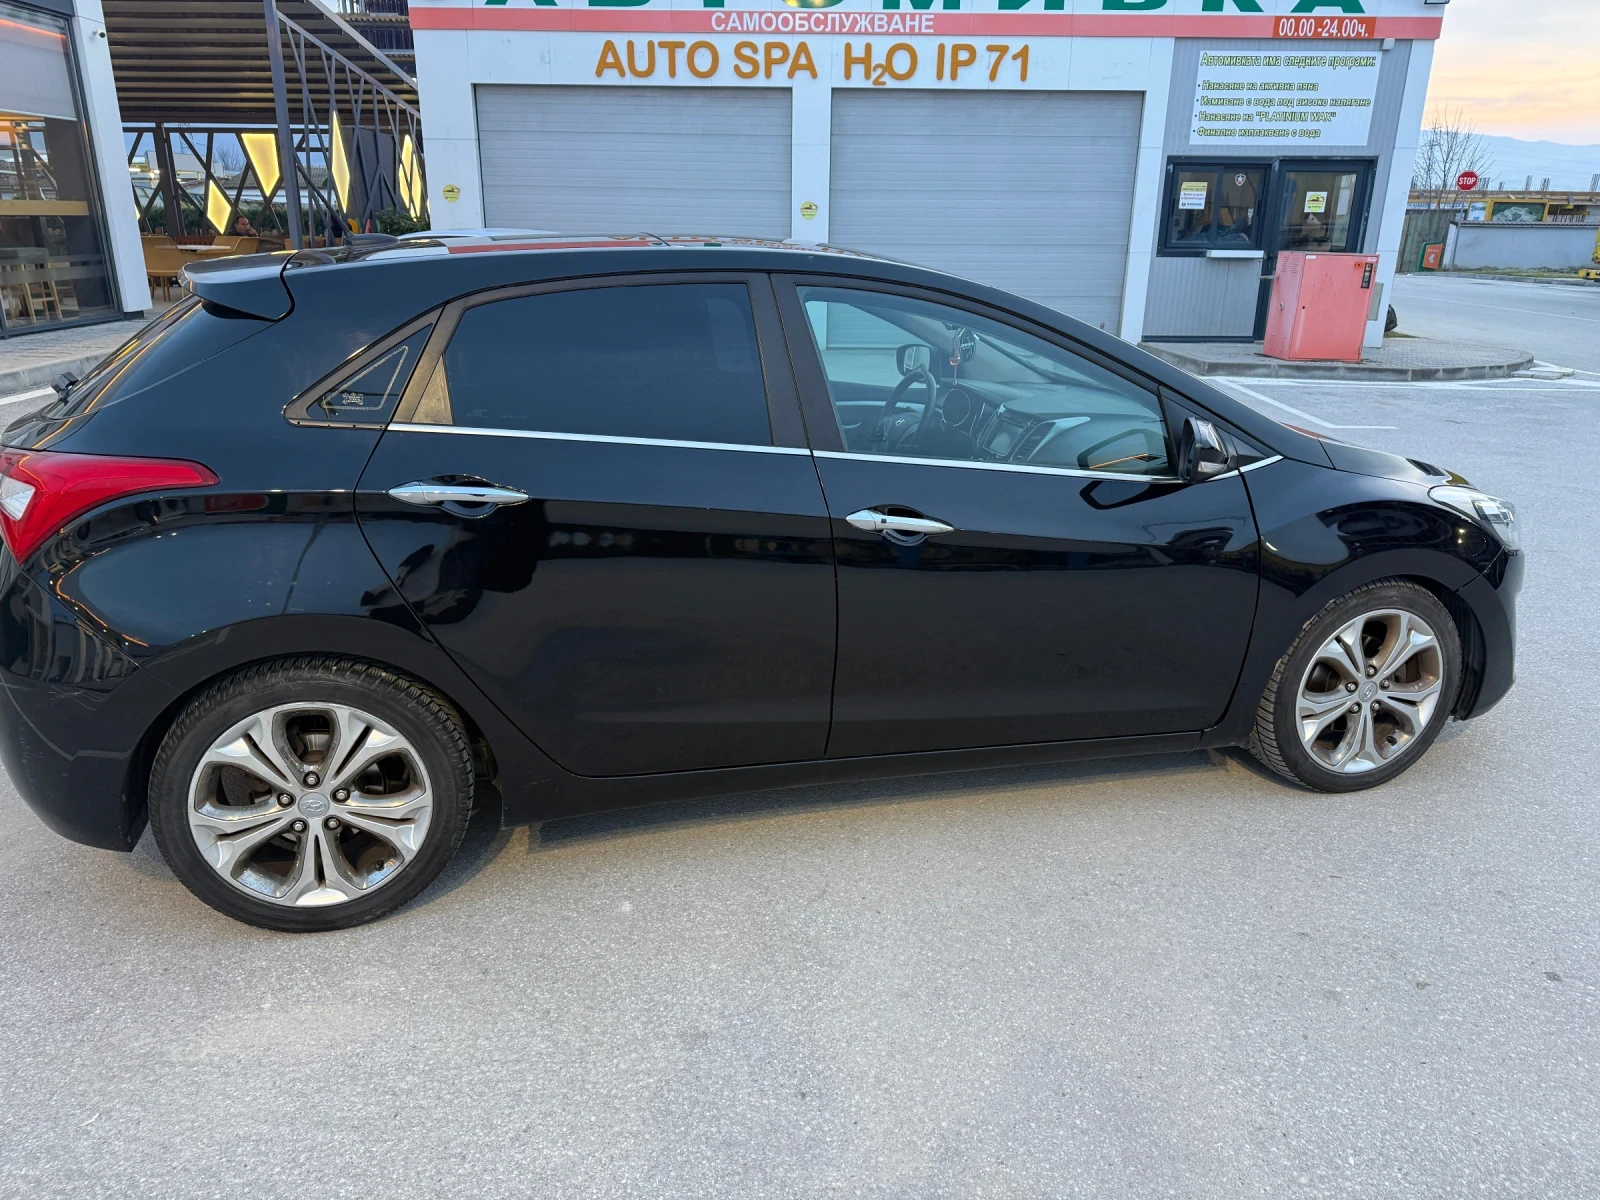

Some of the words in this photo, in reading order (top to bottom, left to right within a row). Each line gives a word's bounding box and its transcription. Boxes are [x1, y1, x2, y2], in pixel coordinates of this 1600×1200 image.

[711, 12, 935, 34] САМООБСЛУЖВАНЕ
[595, 39, 720, 80] AUTO
[732, 41, 818, 81] SPA
[937, 44, 976, 82] IP
[986, 44, 1030, 83] 71
[1200, 53, 1261, 66] Автомивката
[1263, 55, 1281, 66] има
[1283, 55, 1326, 68] следните
[1328, 56, 1376, 69] програми:
[1202, 80, 1245, 91] Нанасяне
[1246, 82, 1257, 91] на
[1259, 83, 1295, 91] активна
[1297, 83, 1319, 91] пяна
[1200, 96, 1244, 106] Измиване
[1246, 98, 1251, 106] с
[1253, 98, 1275, 107] вода
[1277, 98, 1294, 107] под
[1296, 98, 1328, 107] високо
[1329, 98, 1371, 107] налягане
[1198, 111, 1241, 121] Нанасяне
[1242, 113, 1254, 122] на
[1197, 126, 1237, 137] Финално
[1238, 128, 1290, 138] изплакване
[1291, 129, 1297, 137] с
[1298, 129, 1321, 138] вода
[1458, 177, 1476, 185] STOP
